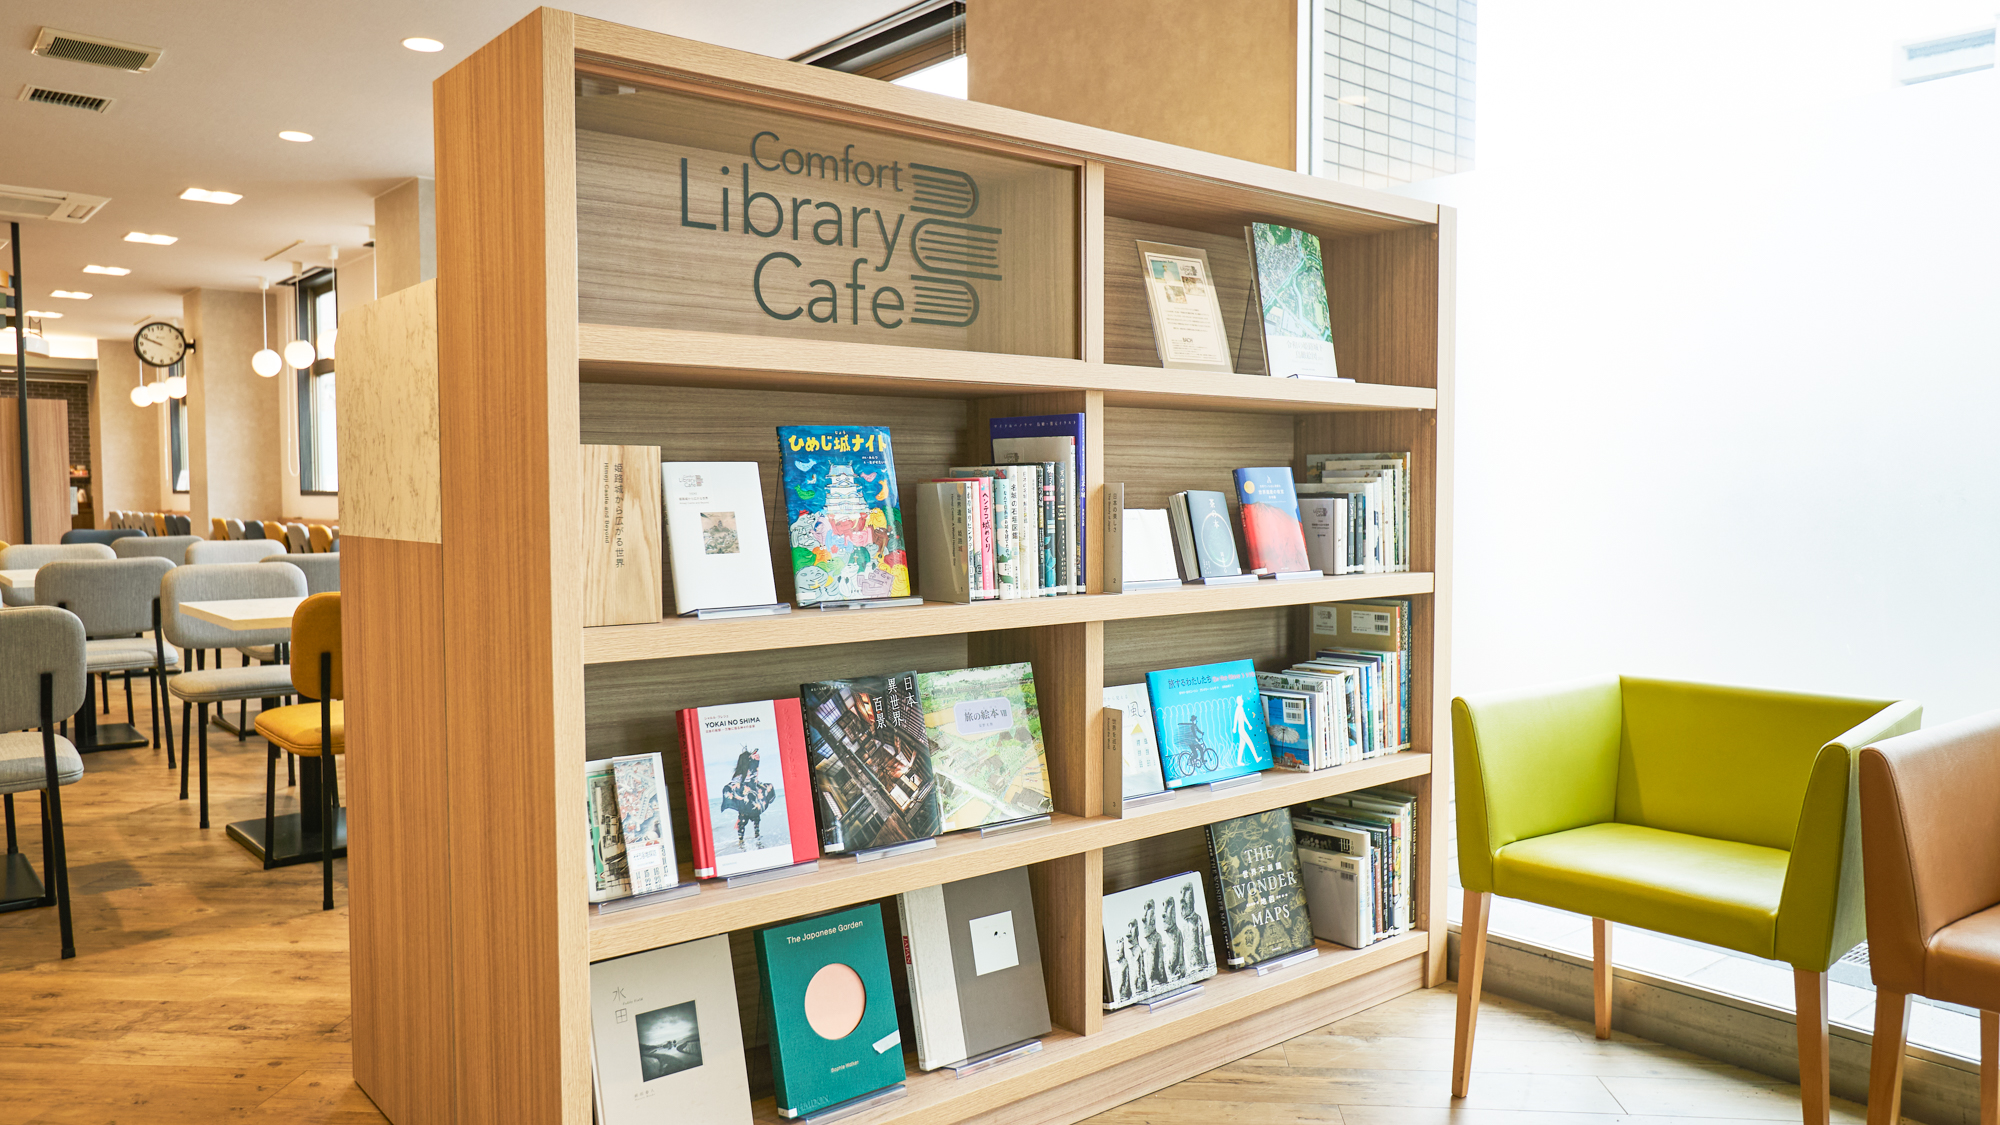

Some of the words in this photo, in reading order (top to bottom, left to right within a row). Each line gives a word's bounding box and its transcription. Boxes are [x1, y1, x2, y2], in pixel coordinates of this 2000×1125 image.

[751, 131, 904, 192] Comfort
[680, 157, 905, 271] Library
[753, 251, 905, 329] Cafe
[788, 434, 887, 452] ひめじ城ナイト
[614, 463, 625, 569] 姫路城から広がる世界
[982, 493, 991, 552] ヘンテコ城めぐり
[1208, 498, 1220, 529] 茶の本
[904, 677, 918, 707] 日本
[1168, 675, 1212, 689] 旅するわたしたち
[873, 696, 887, 729] 百景
[888, 678, 904, 727] 異世界
[965, 708, 999, 722] 旅の絵本
[705, 720, 727, 728] YOKAI
[739, 716, 761, 725] SHIMA
[685, 770, 693, 797] SHIMA
[1245, 844, 1275, 864] THE
[644, 869, 650, 878] 15
[645, 878, 651, 886] 22
[654, 875, 661, 884] 23
[1242, 861, 1282, 878] 世界不思議
[1214, 875, 1223, 911] WONDER
[1233, 871, 1297, 899] WONDER
[1260, 894, 1275, 905] 地図
[1251, 904, 1290, 928] MAPS
[786, 935, 801, 944] The
[802, 927, 837, 941] Japanese
[838, 920, 864, 932] Garden
[903, 938, 912, 964] JAPAN
[612, 986, 628, 1024] 水田
[831, 1064, 846, 1073] Sophie
[845, 1060, 859, 1068] Walker
